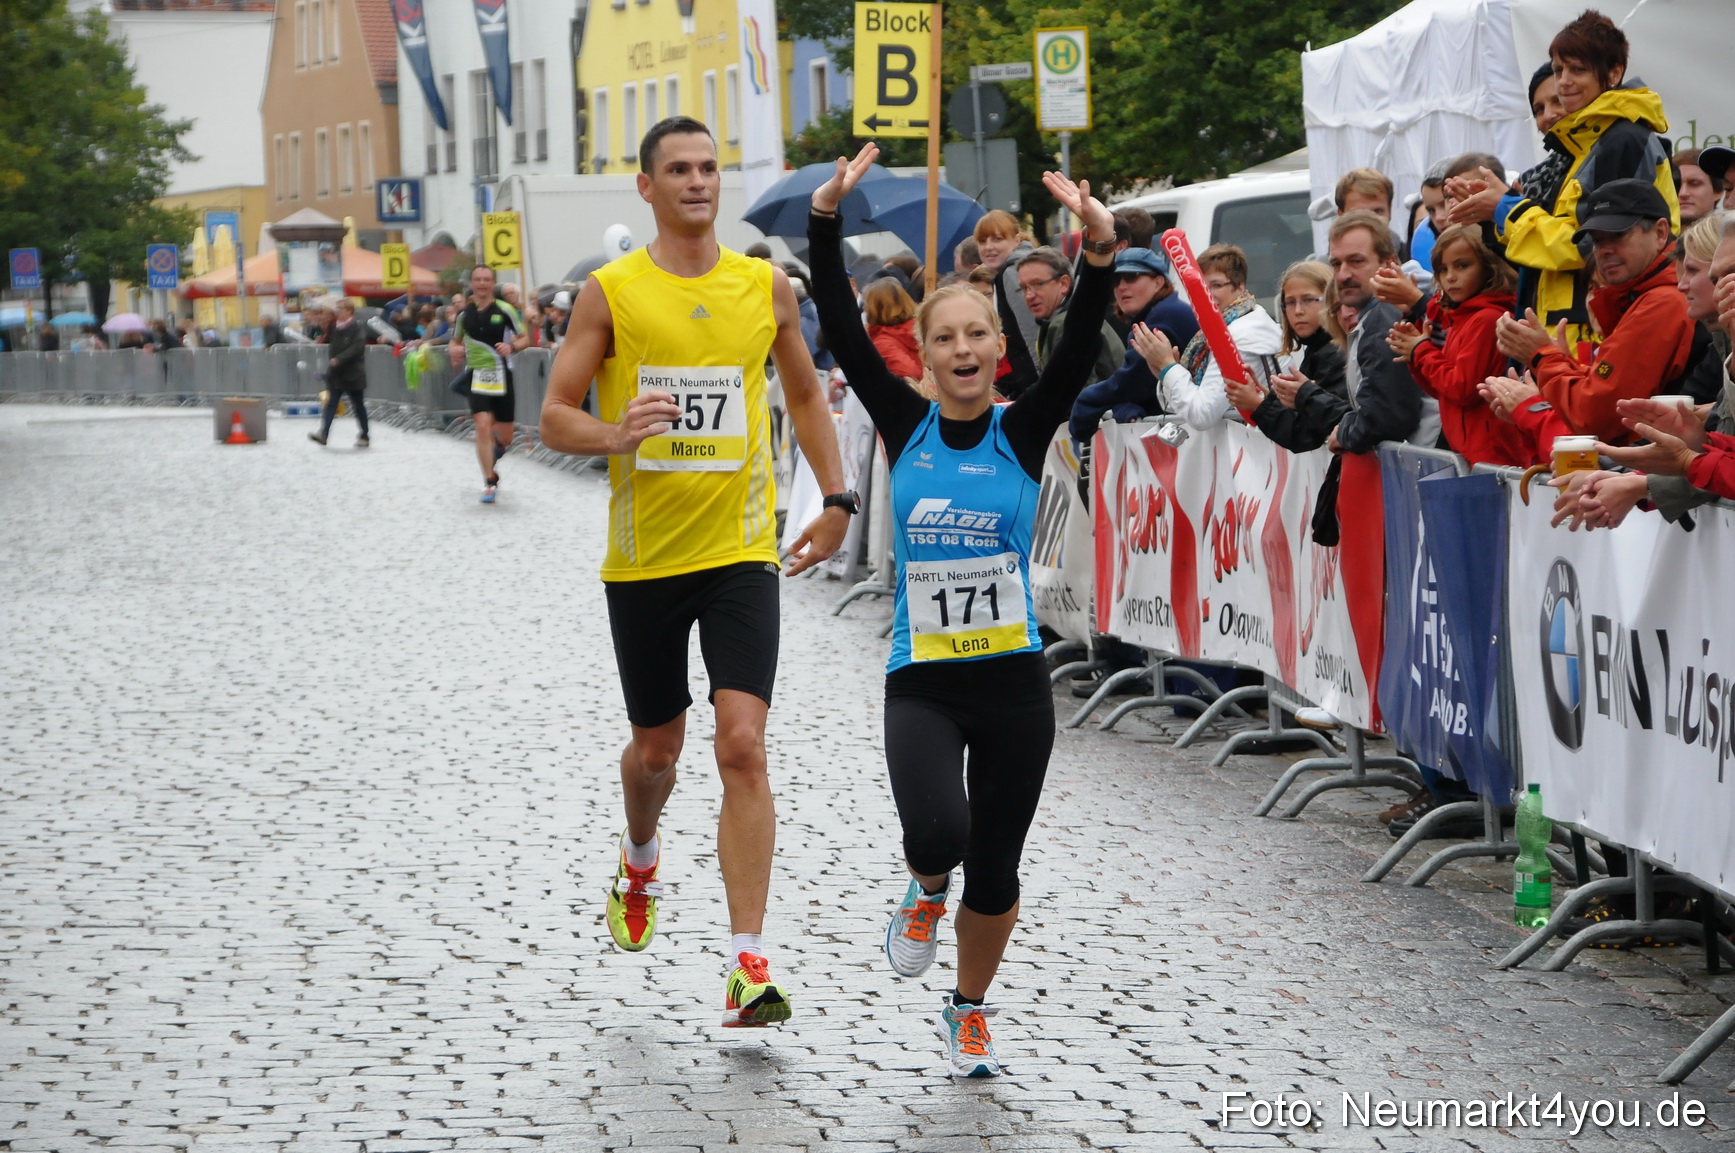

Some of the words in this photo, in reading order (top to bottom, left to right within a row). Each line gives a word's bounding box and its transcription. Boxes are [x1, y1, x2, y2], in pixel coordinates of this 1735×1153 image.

[866, 8, 931, 32] Block
[628, 41, 655, 71] HOTEL
[1053, 44, 1071, 66] H
[877, 44, 918, 106] B
[1674, 119, 1735, 153] de
[486, 215, 516, 226] Block
[493, 229, 512, 257] C
[389, 257, 403, 277] D
[15, 276, 38, 286] TAXI
[152, 275, 175, 285] TAXI
[640, 376, 677, 387] PARTL
[680, 378, 730, 387] Neumarkt
[671, 442, 716, 456] Marco
[913, 461, 934, 470] erima
[921, 512, 999, 530] NAGEL
[946, 507, 1002, 518] Versicherungsbüro
[908, 534, 937, 545] TSG
[941, 534, 960, 545] 08
[964, 535, 999, 547] Roth
[908, 571, 945, 583] PARTL
[947, 566, 1004, 581] Neumarkt
[931, 582, 1000, 628] 171
[914, 625, 920, 634] A
[952, 636, 990, 653] Lena
